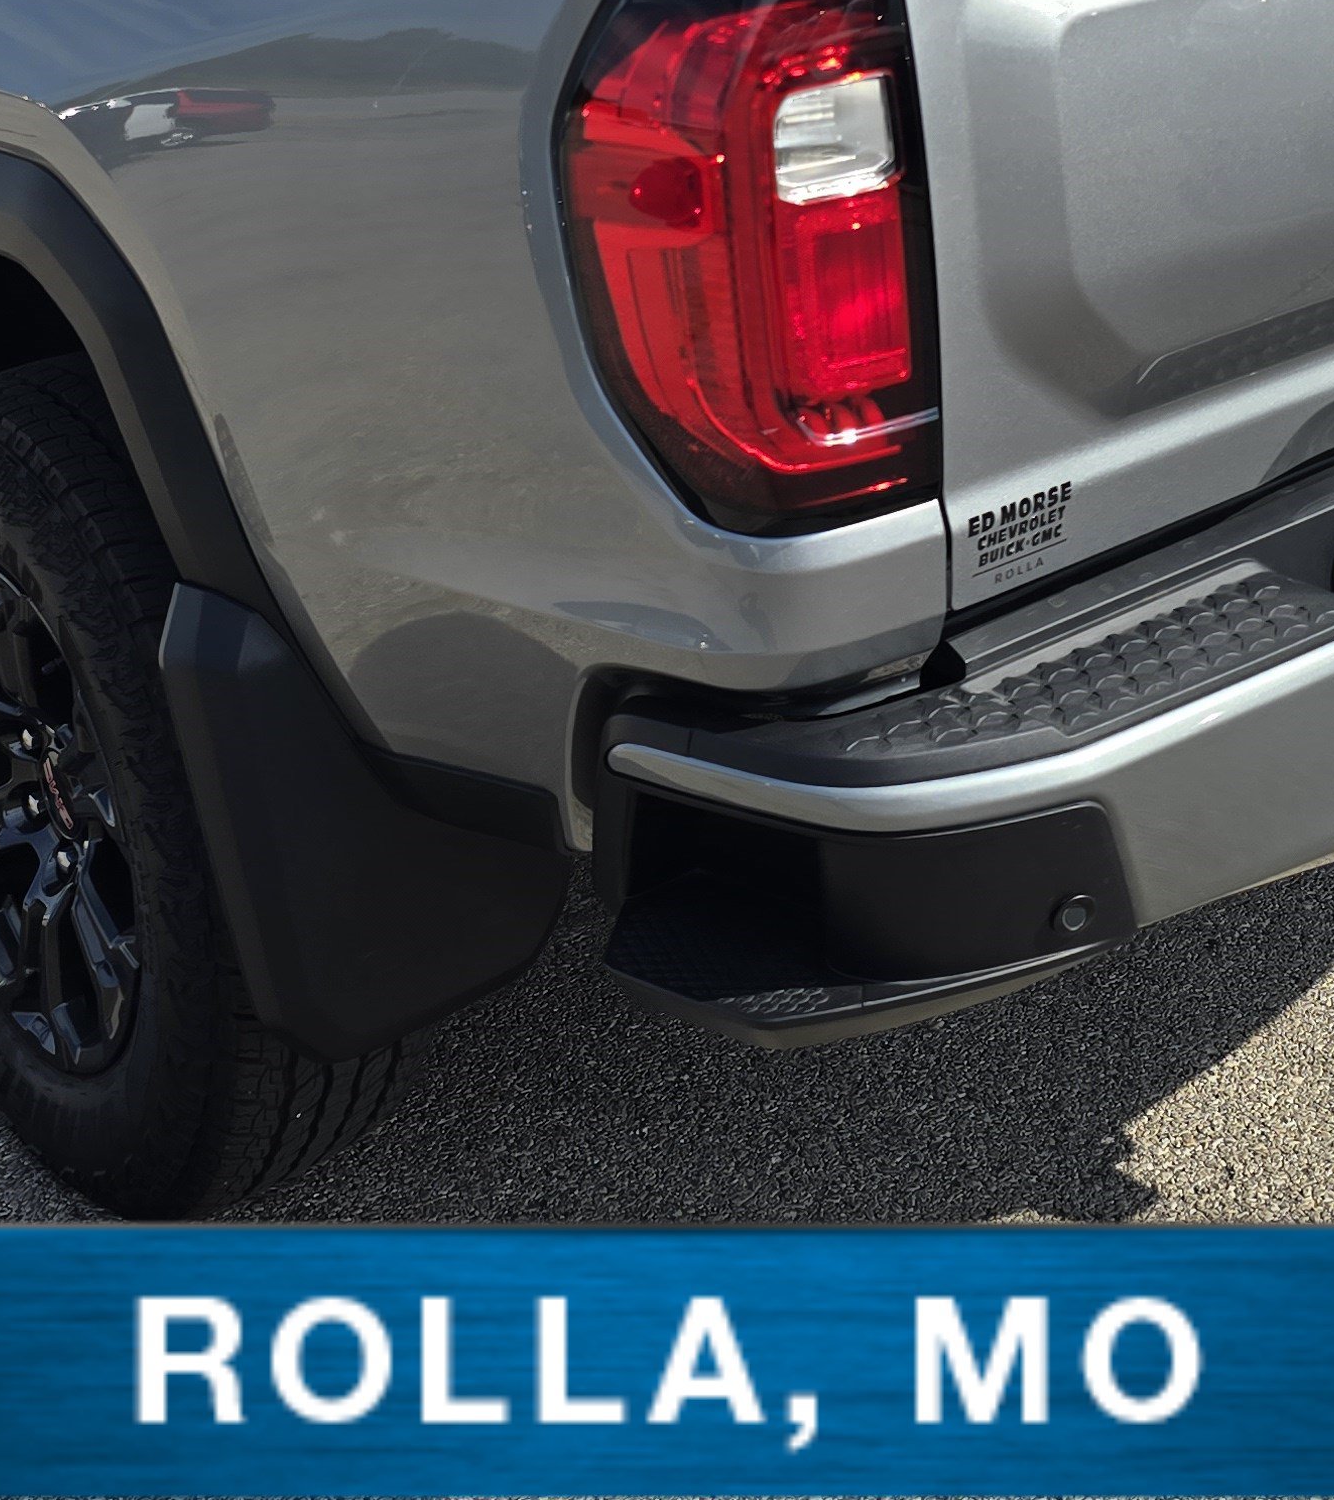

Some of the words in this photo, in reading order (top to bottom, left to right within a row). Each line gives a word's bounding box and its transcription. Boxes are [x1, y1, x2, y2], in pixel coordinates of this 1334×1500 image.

[968, 510, 995, 538] ED
[1000, 481, 1072, 526] MORSE
[977, 505, 1066, 551] CHEVROLET
[994, 556, 1045, 585] ROLLA
